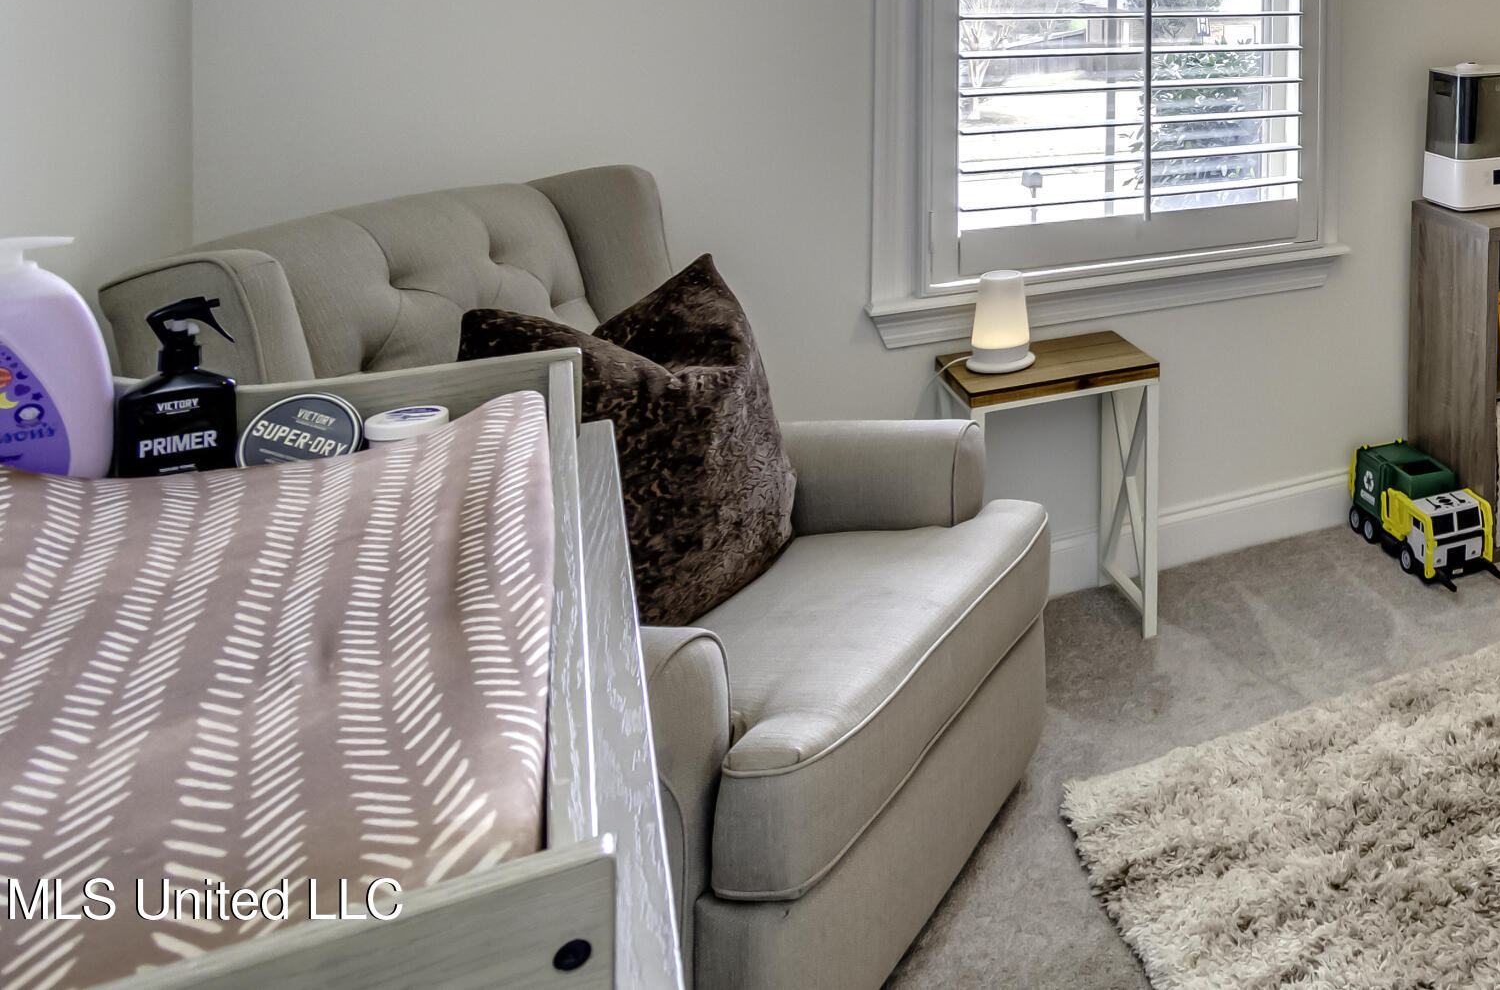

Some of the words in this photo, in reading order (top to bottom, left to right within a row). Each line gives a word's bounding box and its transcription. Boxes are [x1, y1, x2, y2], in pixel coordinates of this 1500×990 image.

[156, 397, 200, 412] VICTORY
[297, 408, 337, 427] VICTORY
[138, 430, 218, 459] PRIMER
[252, 419, 349, 457] SUPER-DRY
